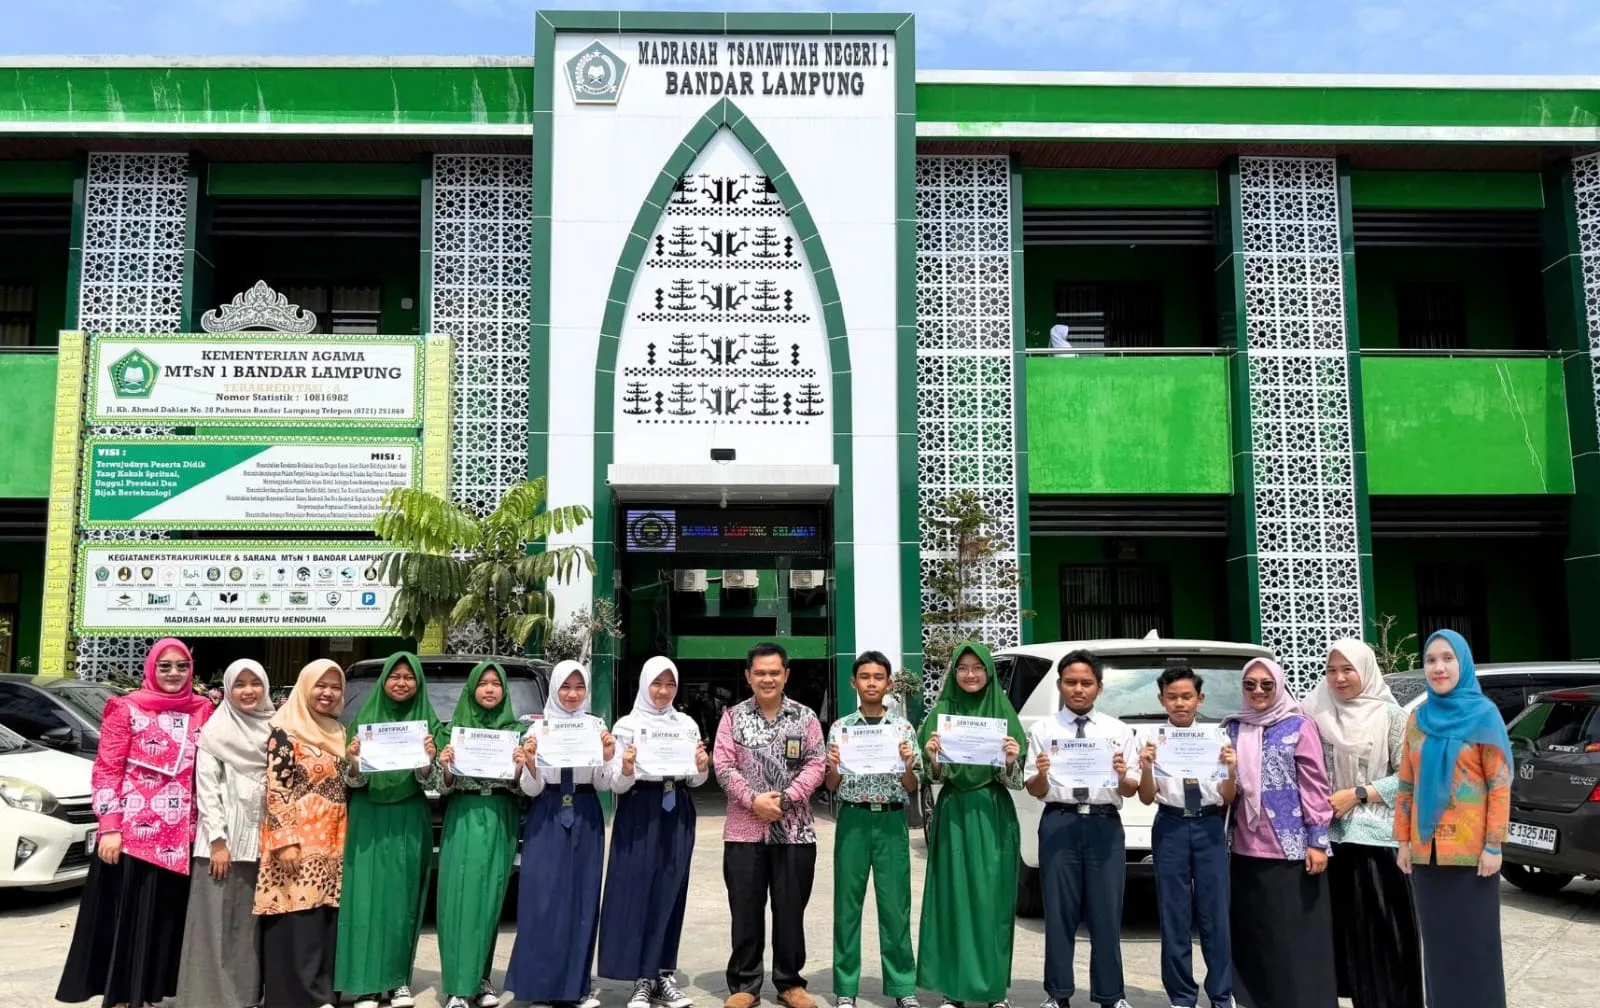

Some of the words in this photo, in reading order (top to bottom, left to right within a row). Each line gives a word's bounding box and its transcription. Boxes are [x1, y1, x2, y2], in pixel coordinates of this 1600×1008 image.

[638, 41, 718, 65] MADRASAH
[727, 41, 819, 66] TSANAWIYAH
[824, 43, 879, 67] NEGERI
[882, 43, 889, 66] 1
[666, 71, 754, 96] BANDAR
[762, 72, 864, 96] LAMPUNG
[201, 350, 308, 361] KEMENTERIAN
[311, 351, 365, 362] AGAMA
[165, 365, 214, 378] MTsN
[221, 366, 228, 378] 1
[233, 366, 307, 379] BANDAR
[311, 366, 401, 380] LAMPUNG
[216, 393, 250, 401] Nomor
[252, 393, 293, 401] Statistik
[283, 407, 320, 415] Lampung
[321, 407, 352, 415] Telepon
[96, 461, 149, 469] Terwujudnya
[95, 480, 124, 488] Unggul
[349, 554, 383, 562] LAMPUN
[164, 616, 211, 624] MADRASAH
[1517, 825, 1538, 840] 1325
[1538, 828, 1555, 843] AAG
